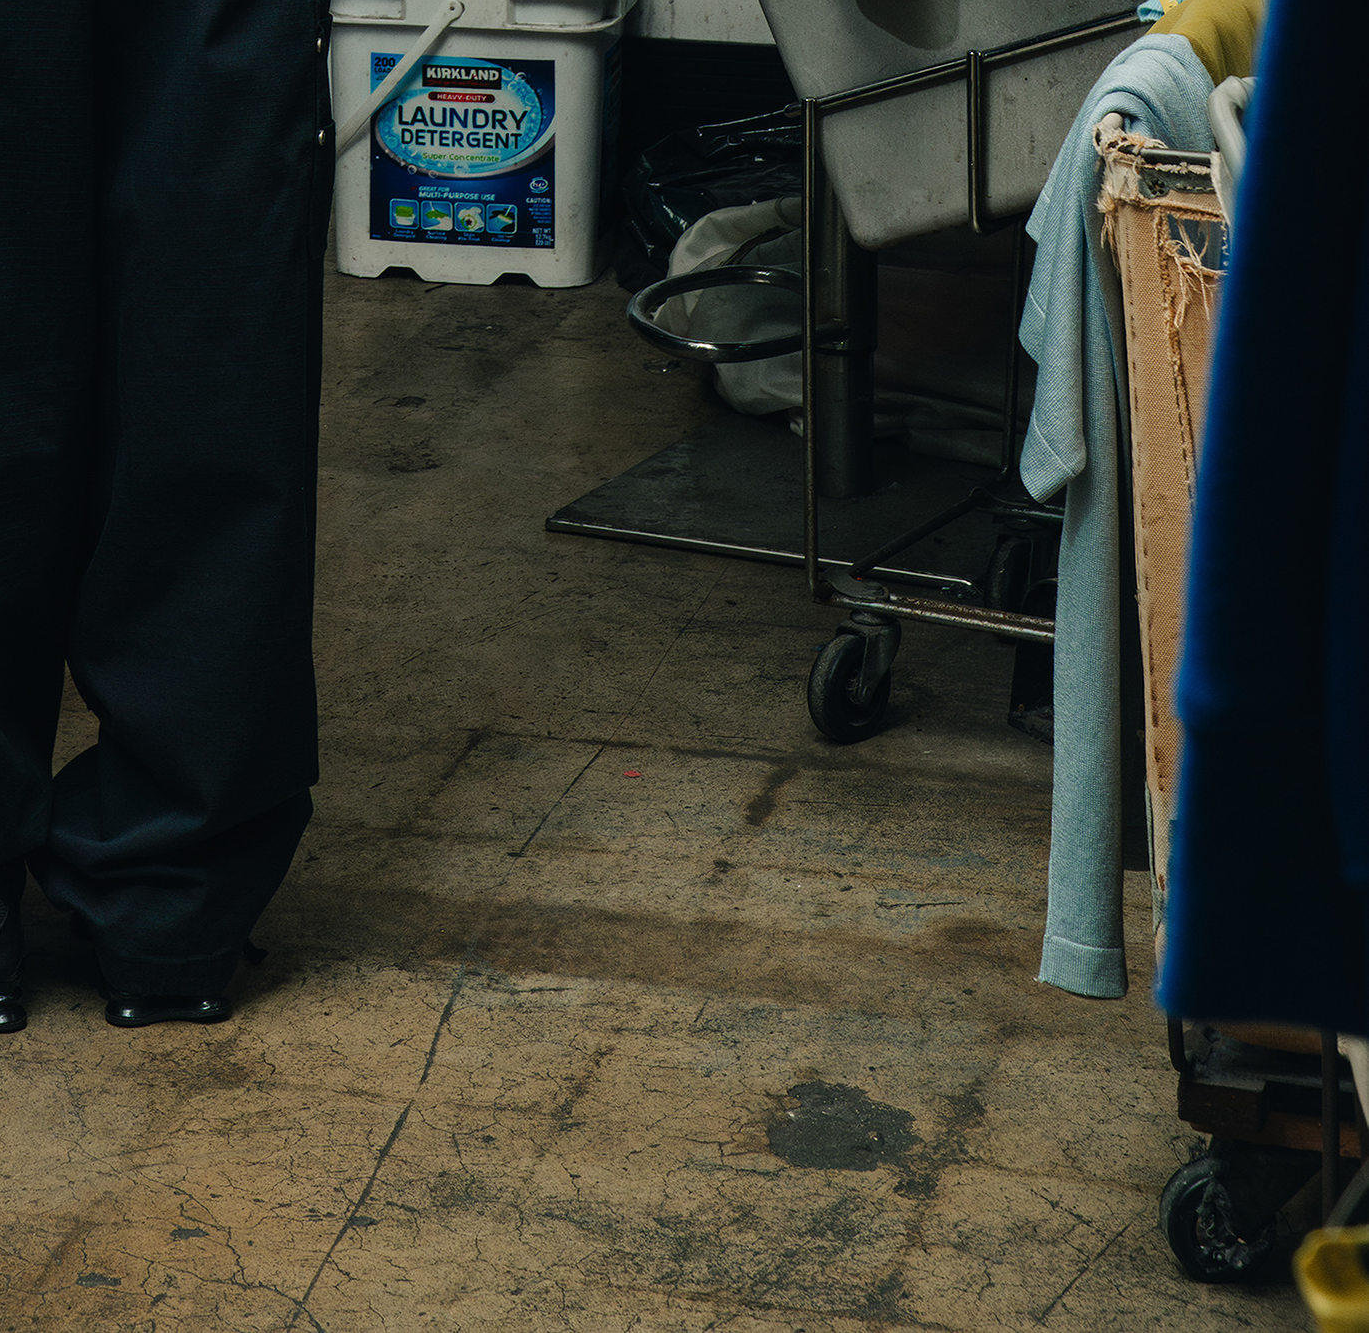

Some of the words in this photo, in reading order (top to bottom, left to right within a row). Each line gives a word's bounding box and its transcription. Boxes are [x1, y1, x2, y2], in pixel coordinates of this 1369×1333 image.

[374, 56, 396, 67] 200
[426, 66, 500, 81] KIRKLAND
[437, 93, 487, 102] HEAVY-DUTY
[398, 104, 529, 131] LAUNDRY
[401, 128, 523, 149] DETERGENT
[422, 152, 447, 162] Super
[449, 153, 500, 163] Concentrate
[418, 191, 479, 200] MULTI-PURPOSE
